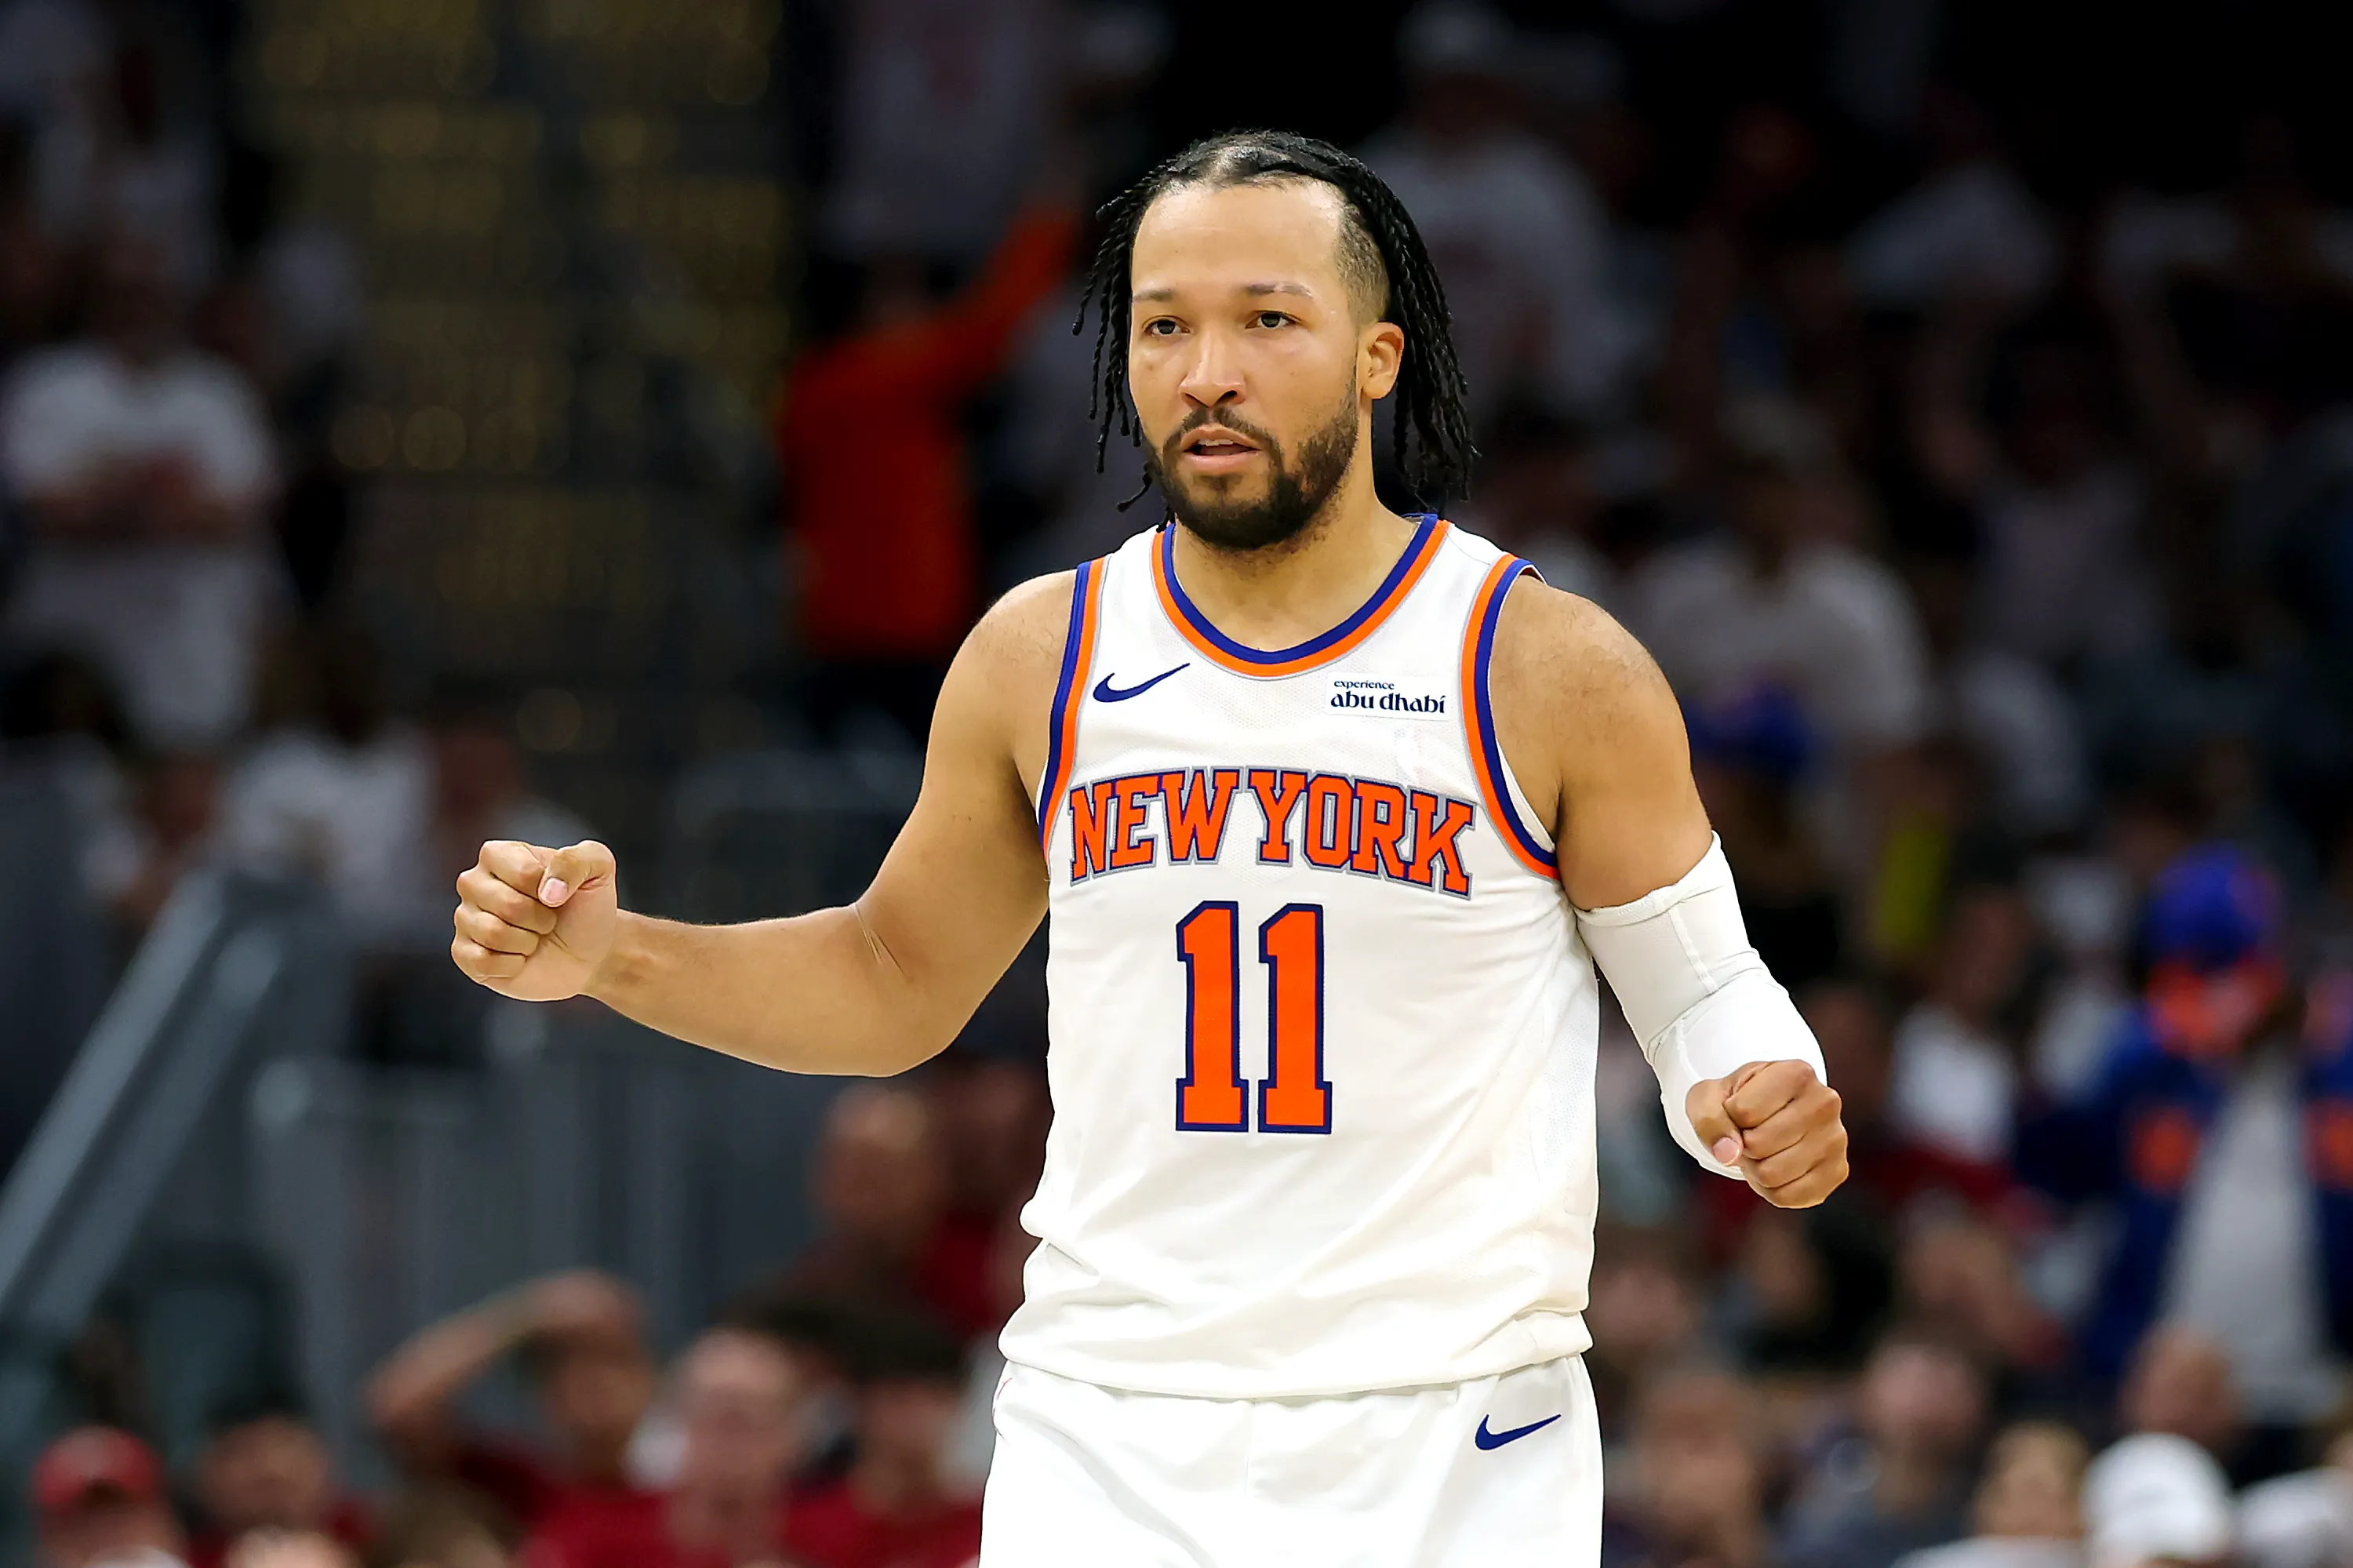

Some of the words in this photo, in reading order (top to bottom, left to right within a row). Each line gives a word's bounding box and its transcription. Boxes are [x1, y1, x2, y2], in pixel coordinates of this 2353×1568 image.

[1330, 690, 1375, 709] abu
[1333, 680, 1395, 690] experience
[1070, 768, 1241, 884] NEW
[1246, 767, 1474, 898] YORK
[1176, 900, 1333, 1134] 11
